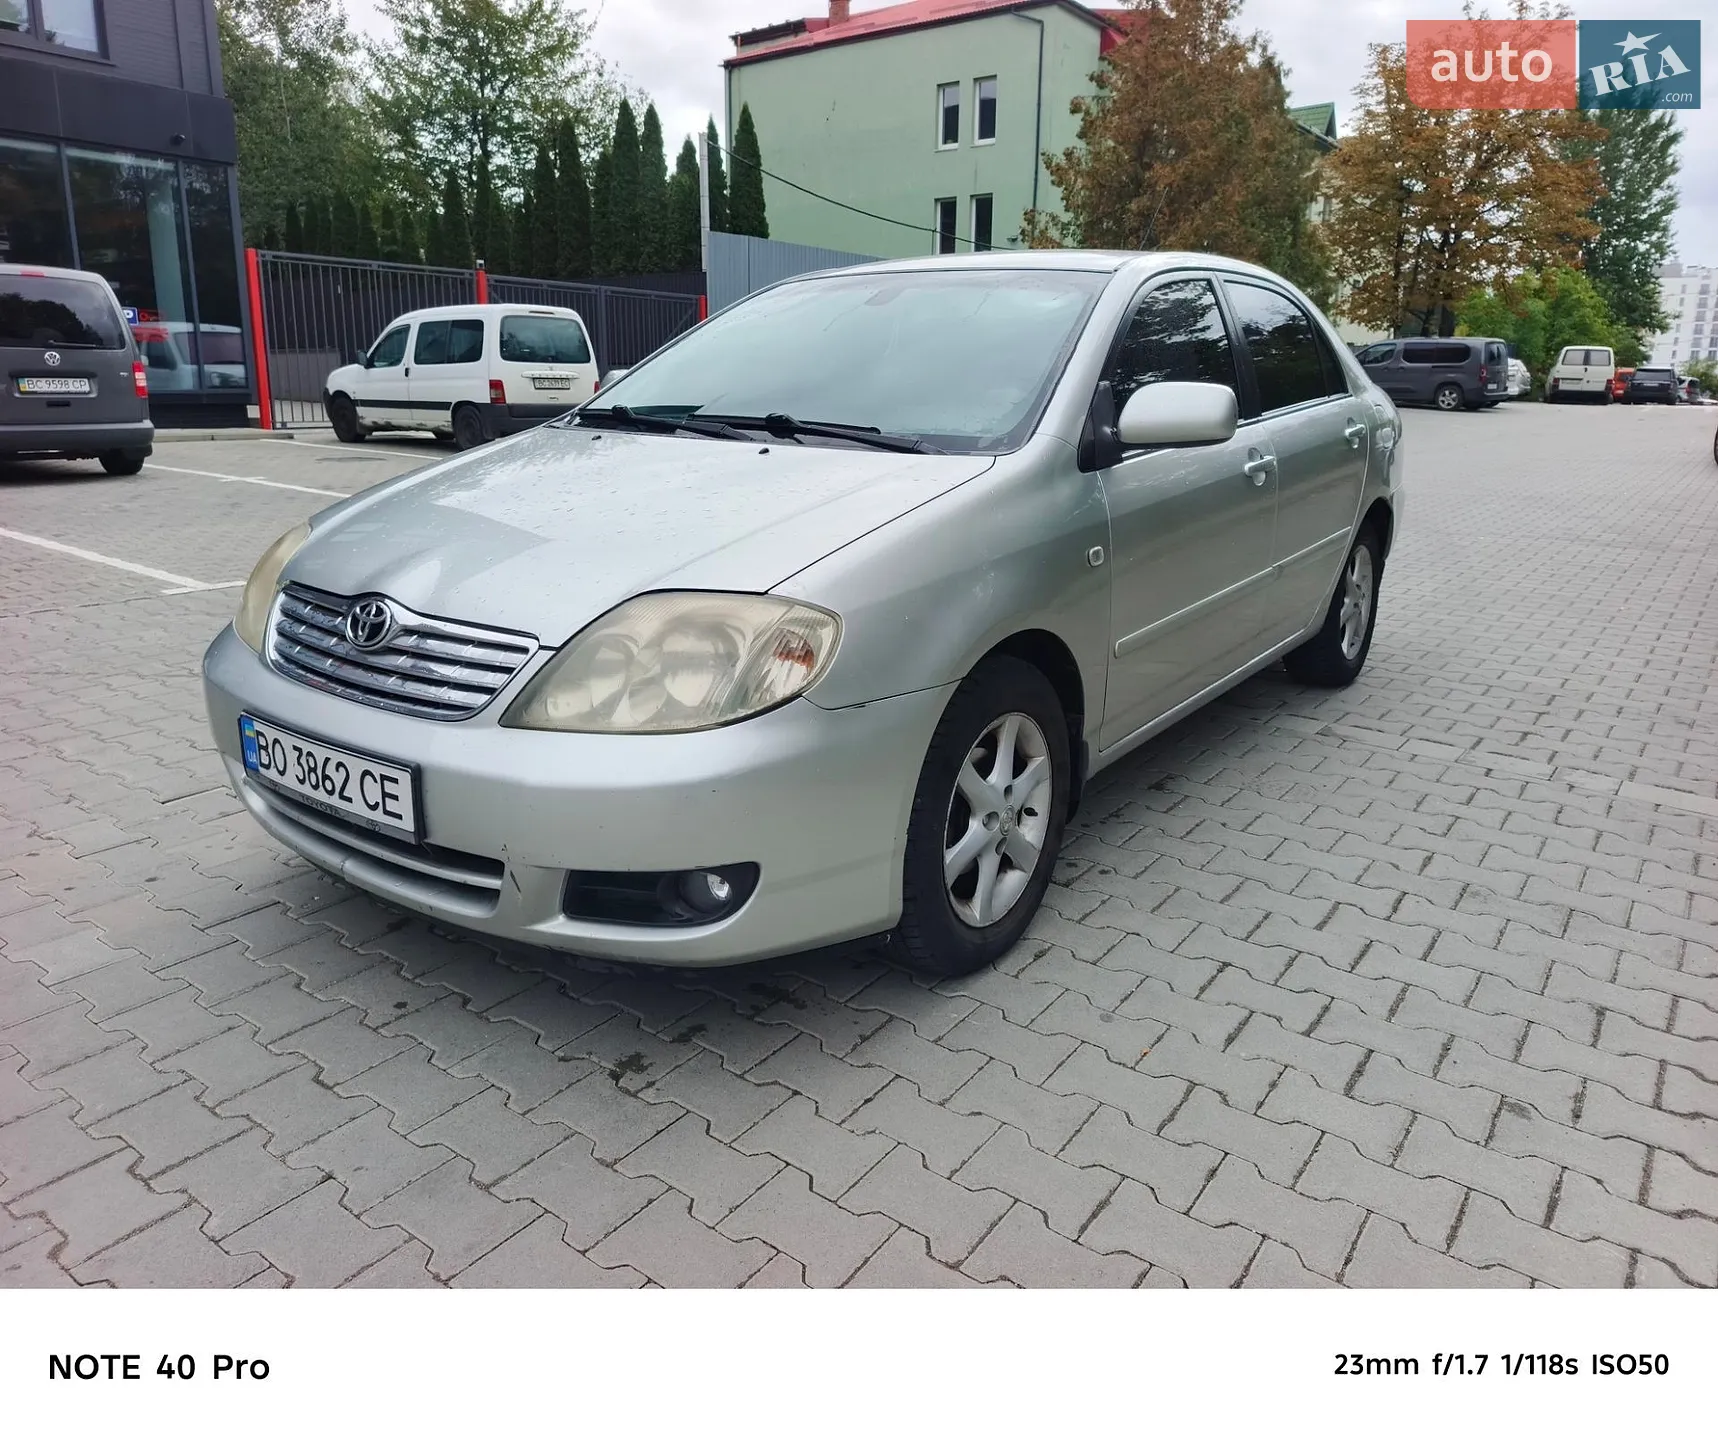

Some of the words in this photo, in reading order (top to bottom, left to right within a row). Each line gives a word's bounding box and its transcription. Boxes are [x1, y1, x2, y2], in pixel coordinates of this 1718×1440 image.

[26, 379, 44, 390] BC
[45, 379, 70, 390] 9598
[71, 379, 87, 390] CP
[255, 729, 287, 777] BO
[292, 744, 353, 804] 3862
[360, 769, 403, 821] CE
